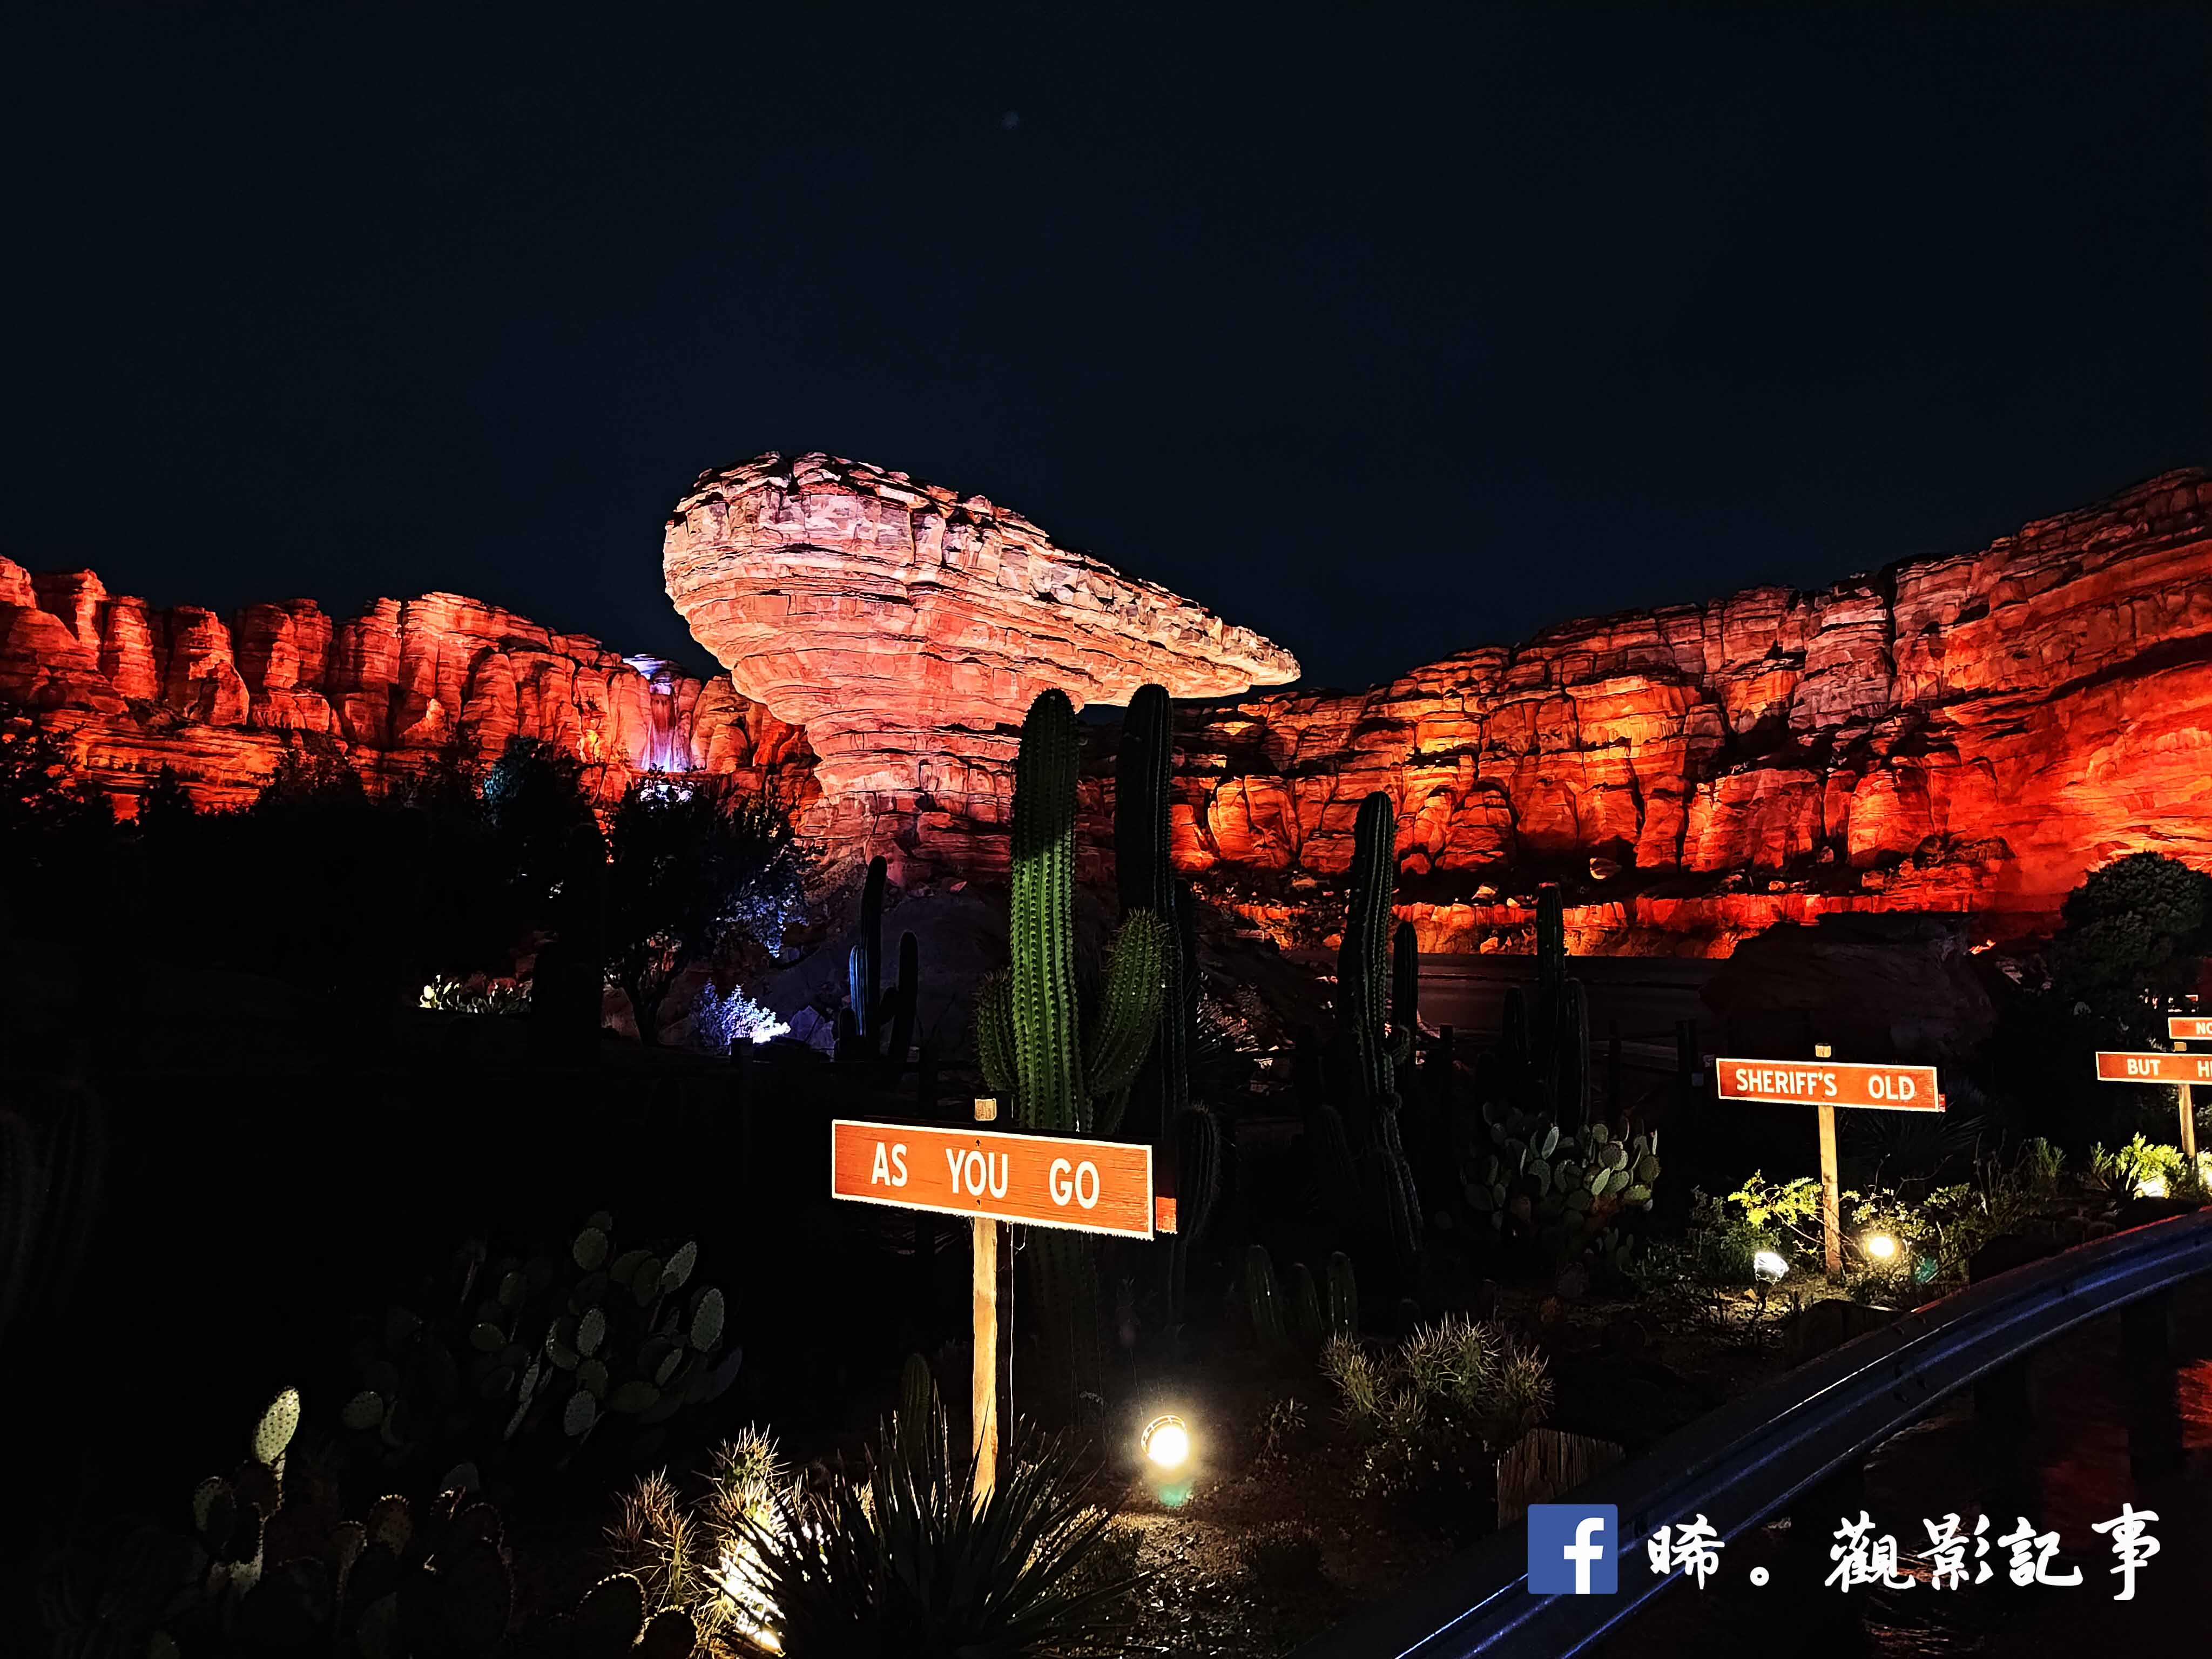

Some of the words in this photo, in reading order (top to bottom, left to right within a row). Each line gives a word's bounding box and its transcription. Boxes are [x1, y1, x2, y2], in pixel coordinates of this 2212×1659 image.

[2127, 1058, 2161, 1076] BUT
[2197, 1060, 2212, 1077] H
[1735, 1068, 1837, 1097] SHERIFF'S
[1868, 1075, 1916, 1101] OLD
[871, 1142, 908, 1187] AS
[945, 1148, 1008, 1198] YOU
[1049, 1158, 1100, 1209] GO
